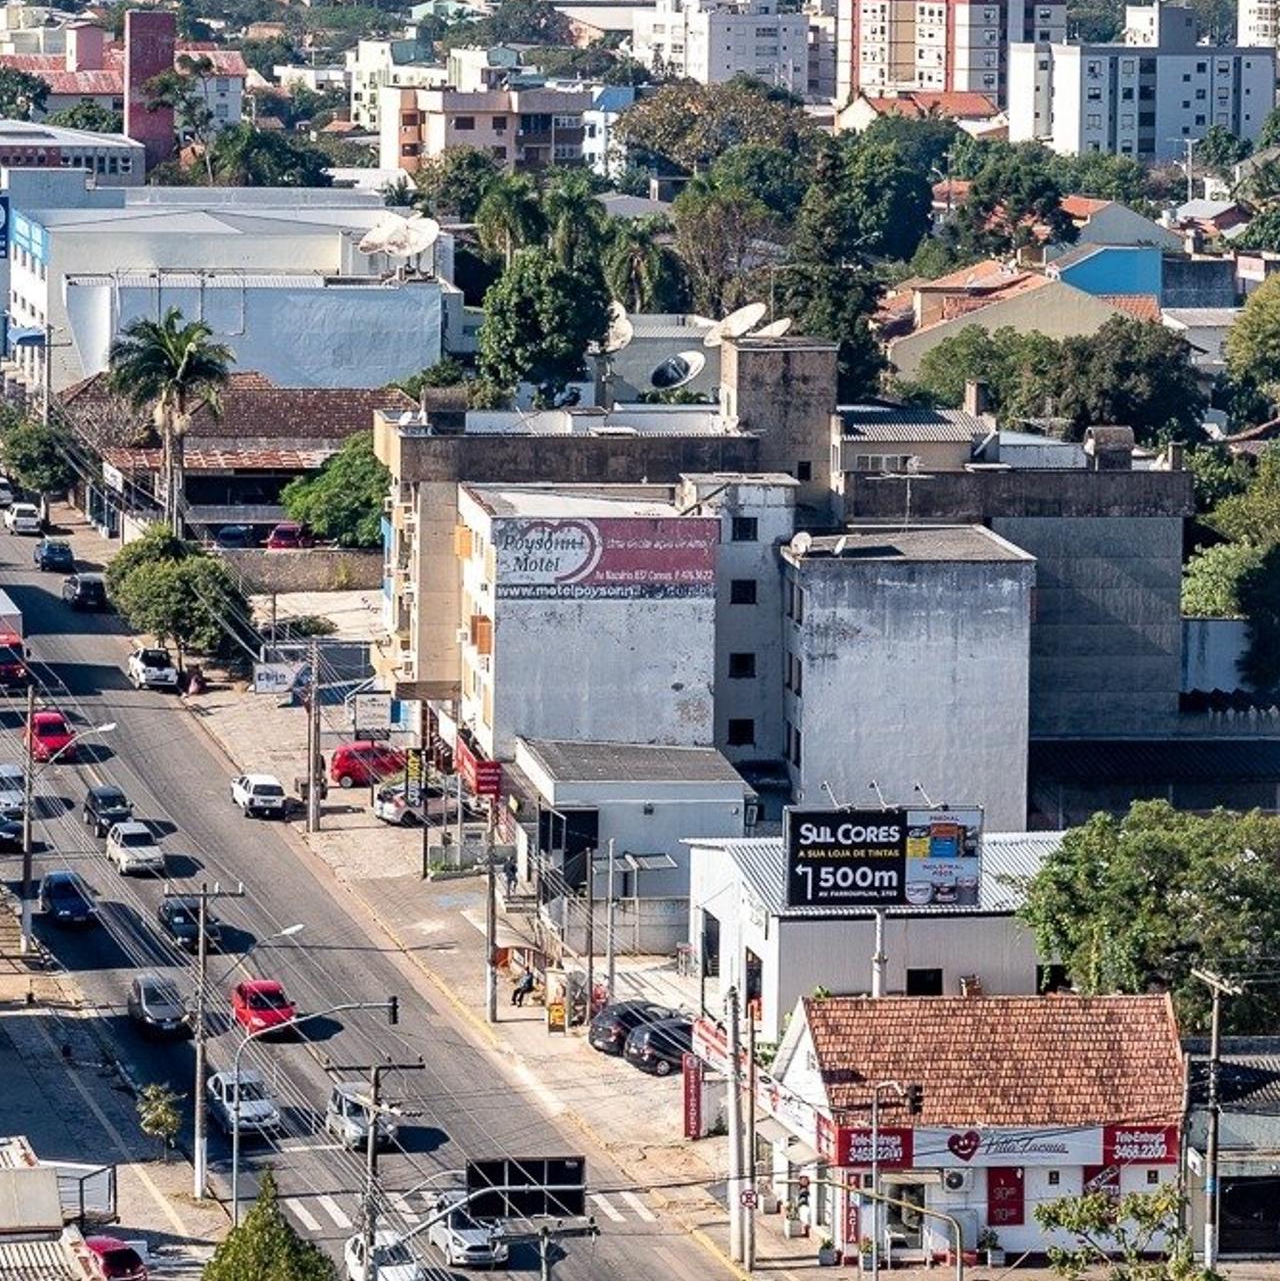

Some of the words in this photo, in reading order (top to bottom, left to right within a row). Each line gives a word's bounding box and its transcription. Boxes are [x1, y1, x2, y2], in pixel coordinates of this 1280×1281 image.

[513, 556, 561, 573] Motel
[799, 823, 835, 845] SUL
[837, 823, 901, 845] CORES
[797, 849, 806, 858] A
[808, 849, 825, 858] SUA
[828, 849, 851, 858] LOJA
[853, 849, 866, 858] DE
[868, 848, 900, 858] TINTAS
[819, 866, 899, 888] 500m
[1116, 1131, 1165, 1144] Tele-Entrega
[849, 1147, 903, 1161] 34682200
[849, 1175, 858, 1243] FACIA
